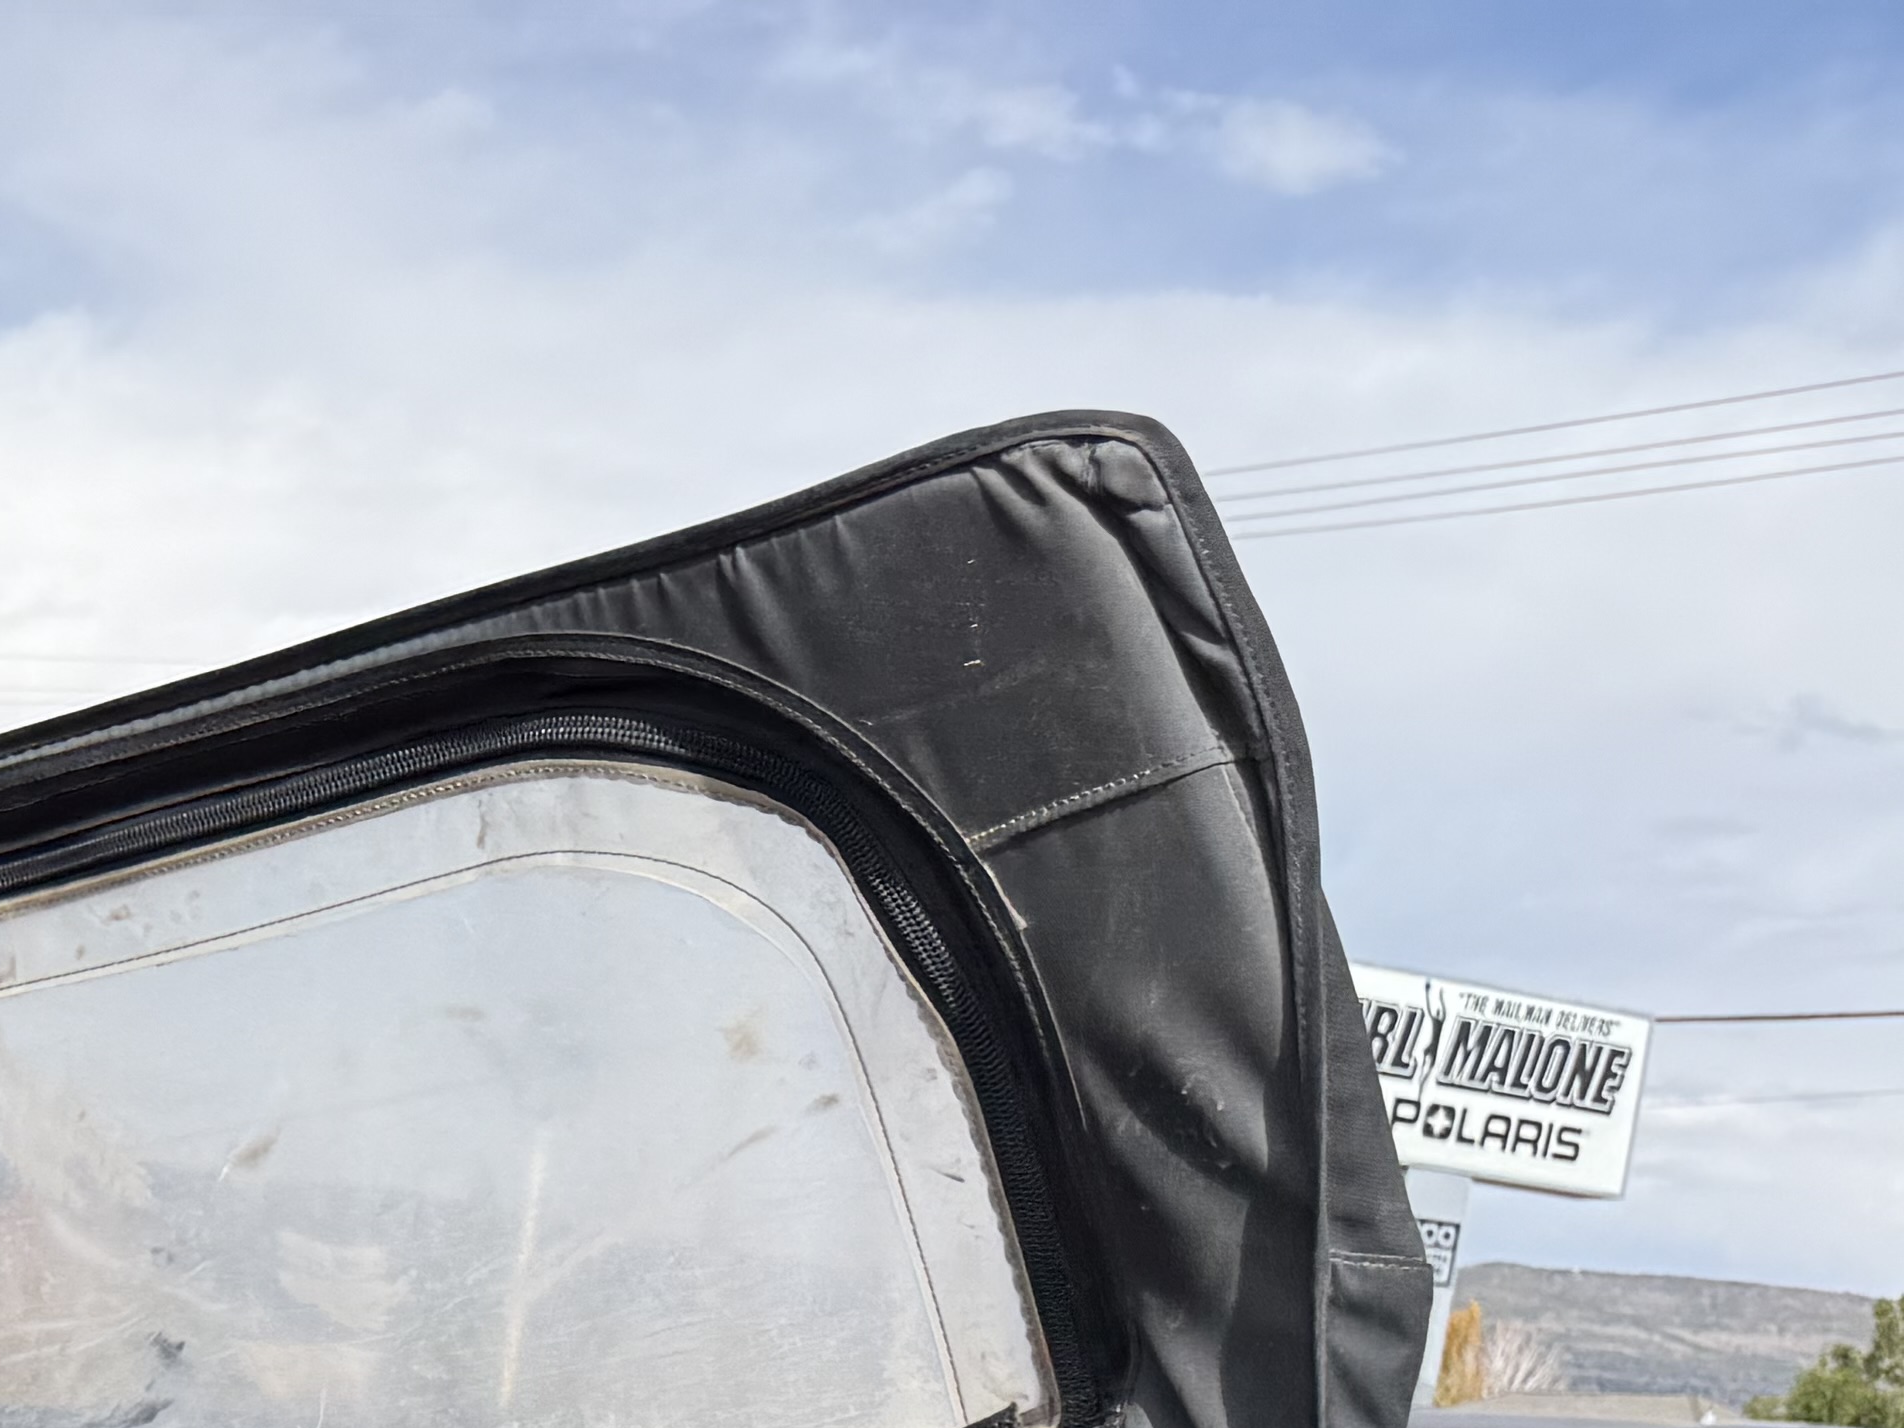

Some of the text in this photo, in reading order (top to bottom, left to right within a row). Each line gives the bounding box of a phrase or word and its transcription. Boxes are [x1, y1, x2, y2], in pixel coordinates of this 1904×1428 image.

[1358, 997, 1632, 1115] RL MALONE
[1391, 1098, 1583, 1161] POLARIS
